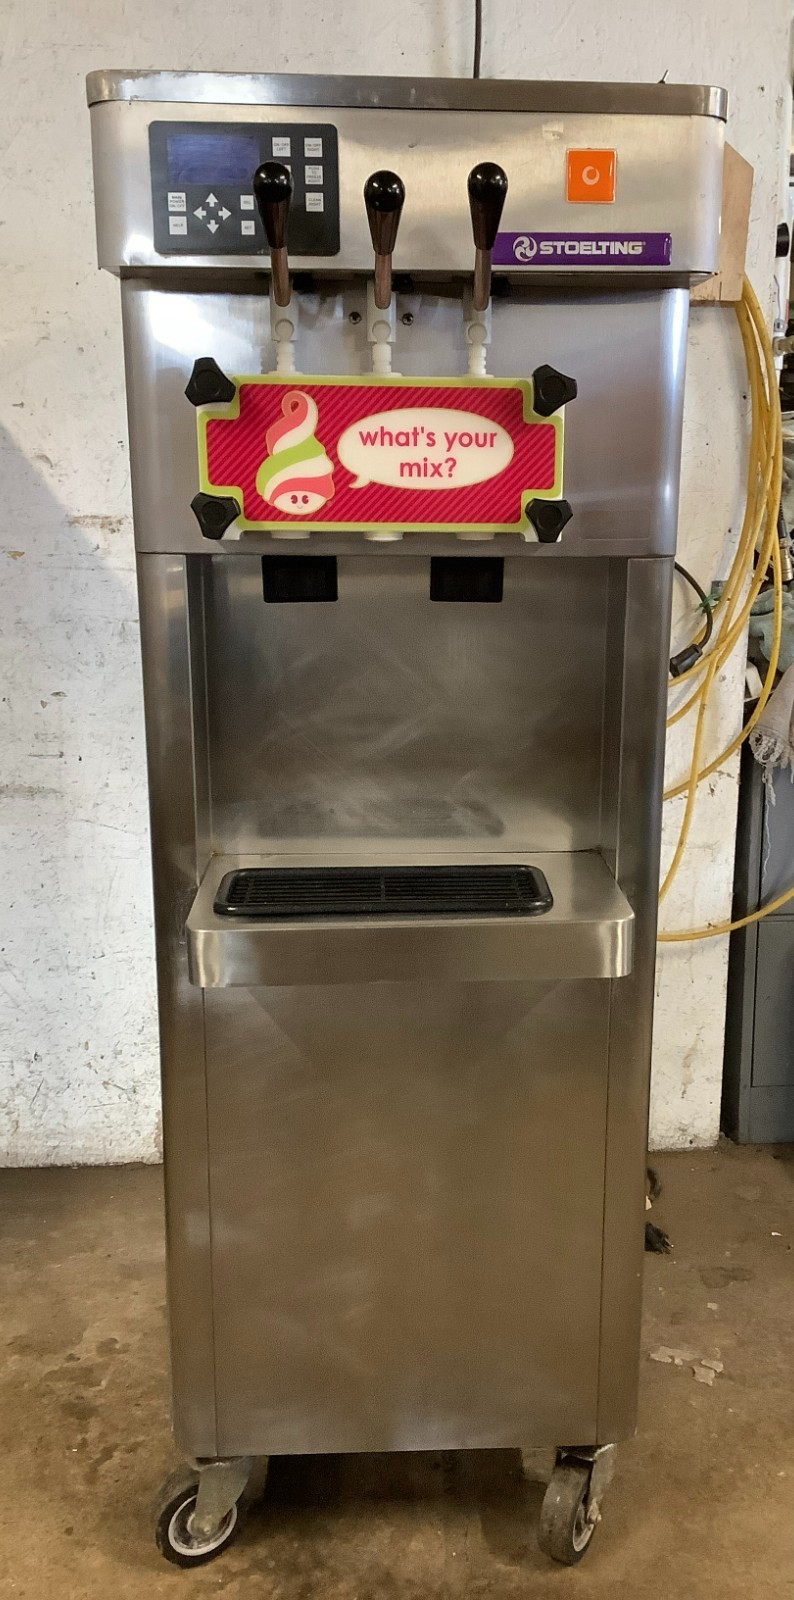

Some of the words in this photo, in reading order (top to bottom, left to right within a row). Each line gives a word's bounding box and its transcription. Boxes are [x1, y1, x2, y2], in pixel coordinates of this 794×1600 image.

[358, 425, 436, 448] what's
[444, 431, 498, 453] your
[399, 456, 457, 478] mix?
